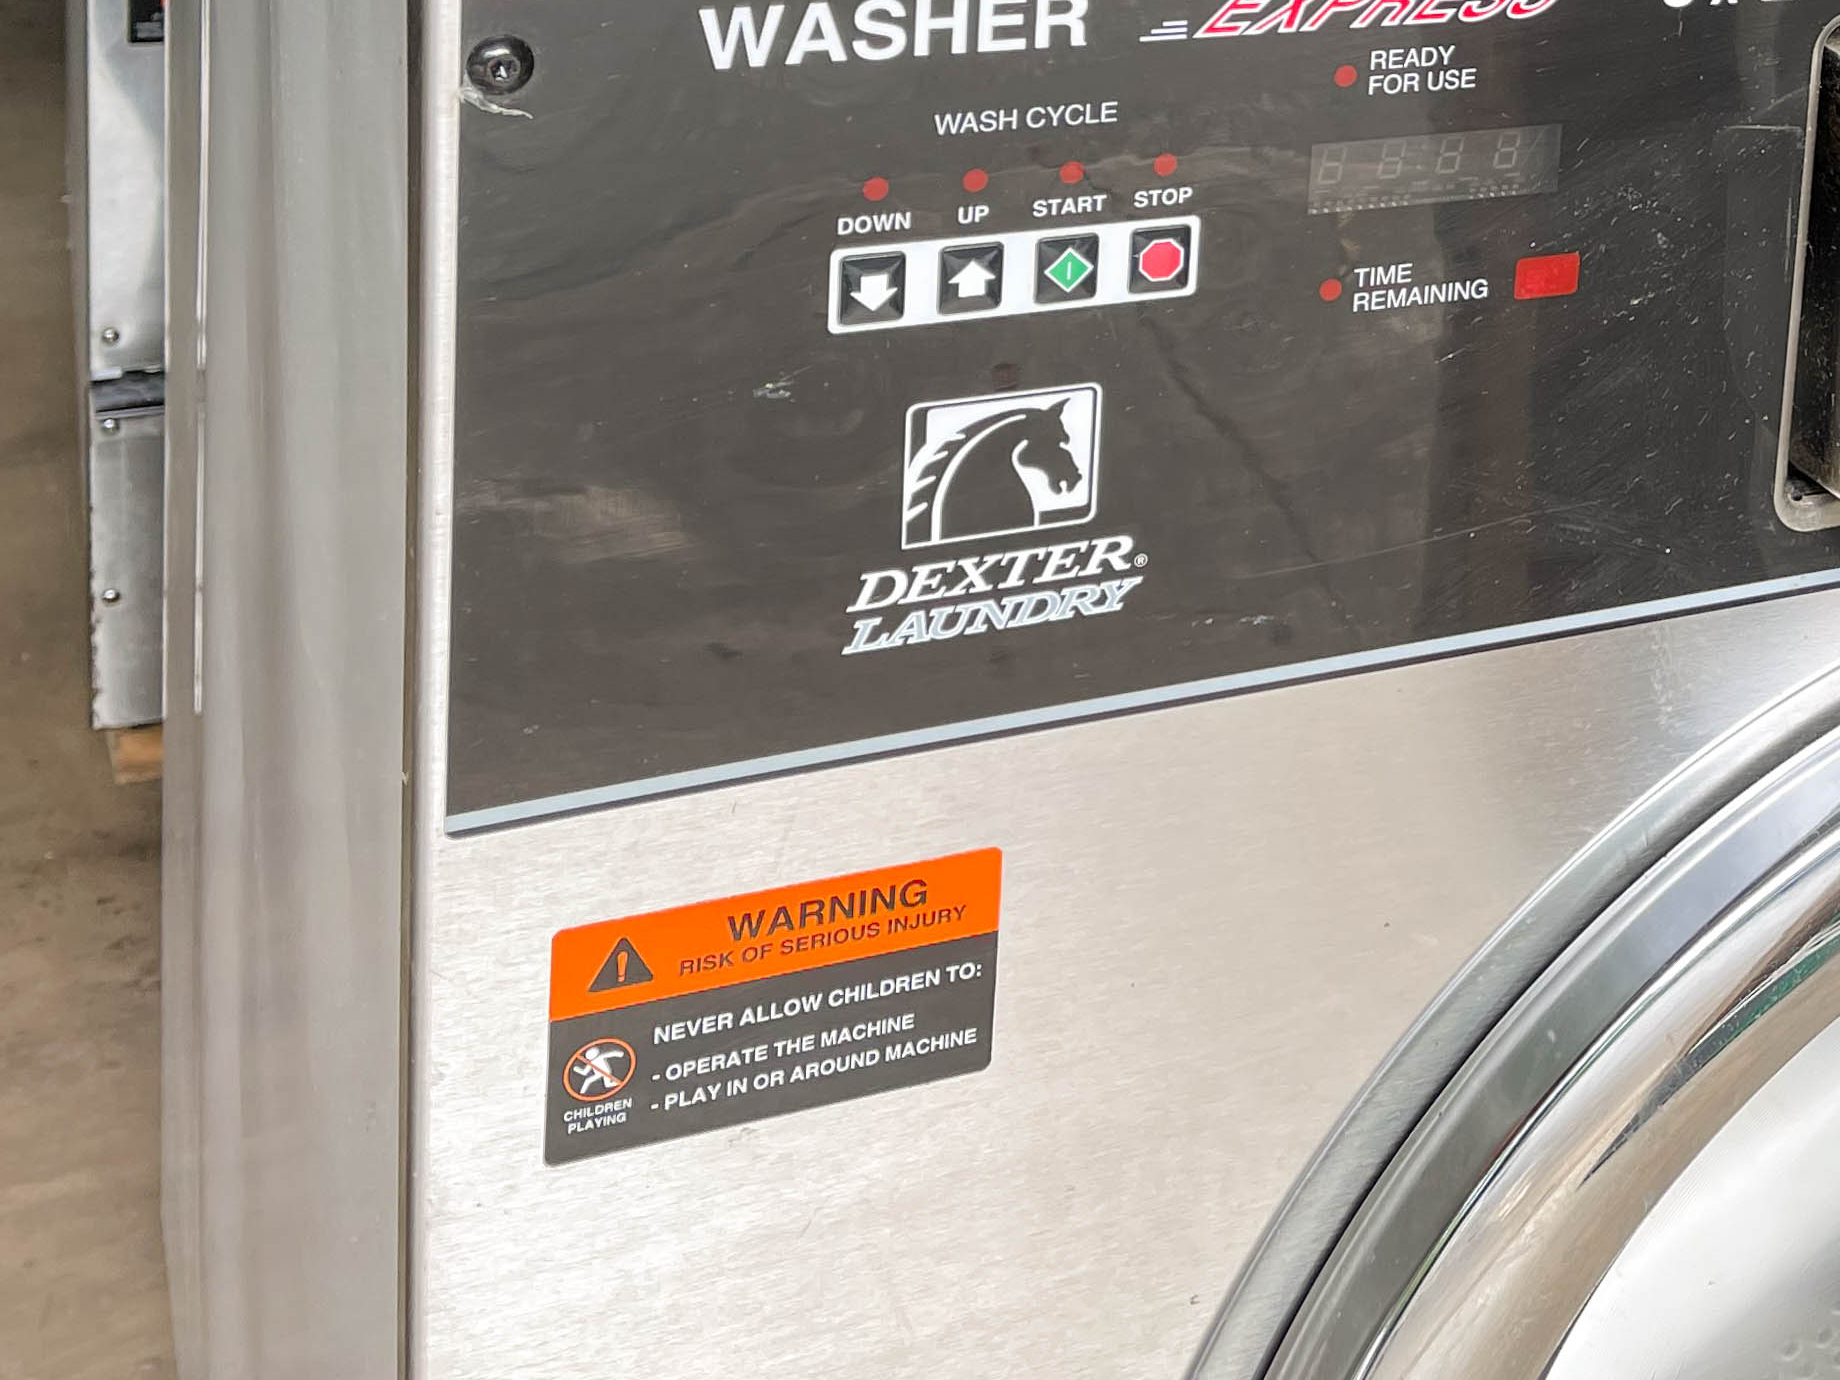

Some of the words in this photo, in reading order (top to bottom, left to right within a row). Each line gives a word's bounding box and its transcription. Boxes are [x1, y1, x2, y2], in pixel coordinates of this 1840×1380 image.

[1369, 45, 1457, 71] READY
[1367, 71, 1420, 95] FOR
[1426, 68, 1478, 92] USE
[934, 108, 1018, 137] WASH
[1025, 101, 1119, 130] CYCLE
[1032, 195, 1108, 218] START
[1133, 186, 1194, 208] STOP
[836, 212, 912, 236] DOWN
[957, 204, 990, 225] UP
[1353, 263, 1413, 288] TIME
[1351, 279, 1490, 313] REMAINING
[841, 575, 1145, 656] LAUNDRY
[727, 878, 929, 943] WARNING
[680, 949, 734, 977] RISK
[741, 944, 770, 964] OF
[780, 921, 881, 957] SERIOUS
[886, 904, 968, 934] INJURY
[653, 1013, 734, 1045] NEVER
[738, 993, 825, 1027] ALLOW
[828, 970, 943, 1007] CHILDREN
[946, 962, 983, 983] TO:
[665, 1046, 770, 1082] OPERATE
[774, 1033, 816, 1058] THE
[819, 1013, 916, 1049] MACHINE
[664, 1080, 723, 1111] PLAY
[726, 1077, 748, 1096] IN
[753, 1069, 786, 1091] OR
[789, 1048, 880, 1083] AROUND
[884, 1027, 978, 1063] MACHINE
[563, 1097, 633, 1123] CHILDREN
[567, 1112, 627, 1135] PLAYING
